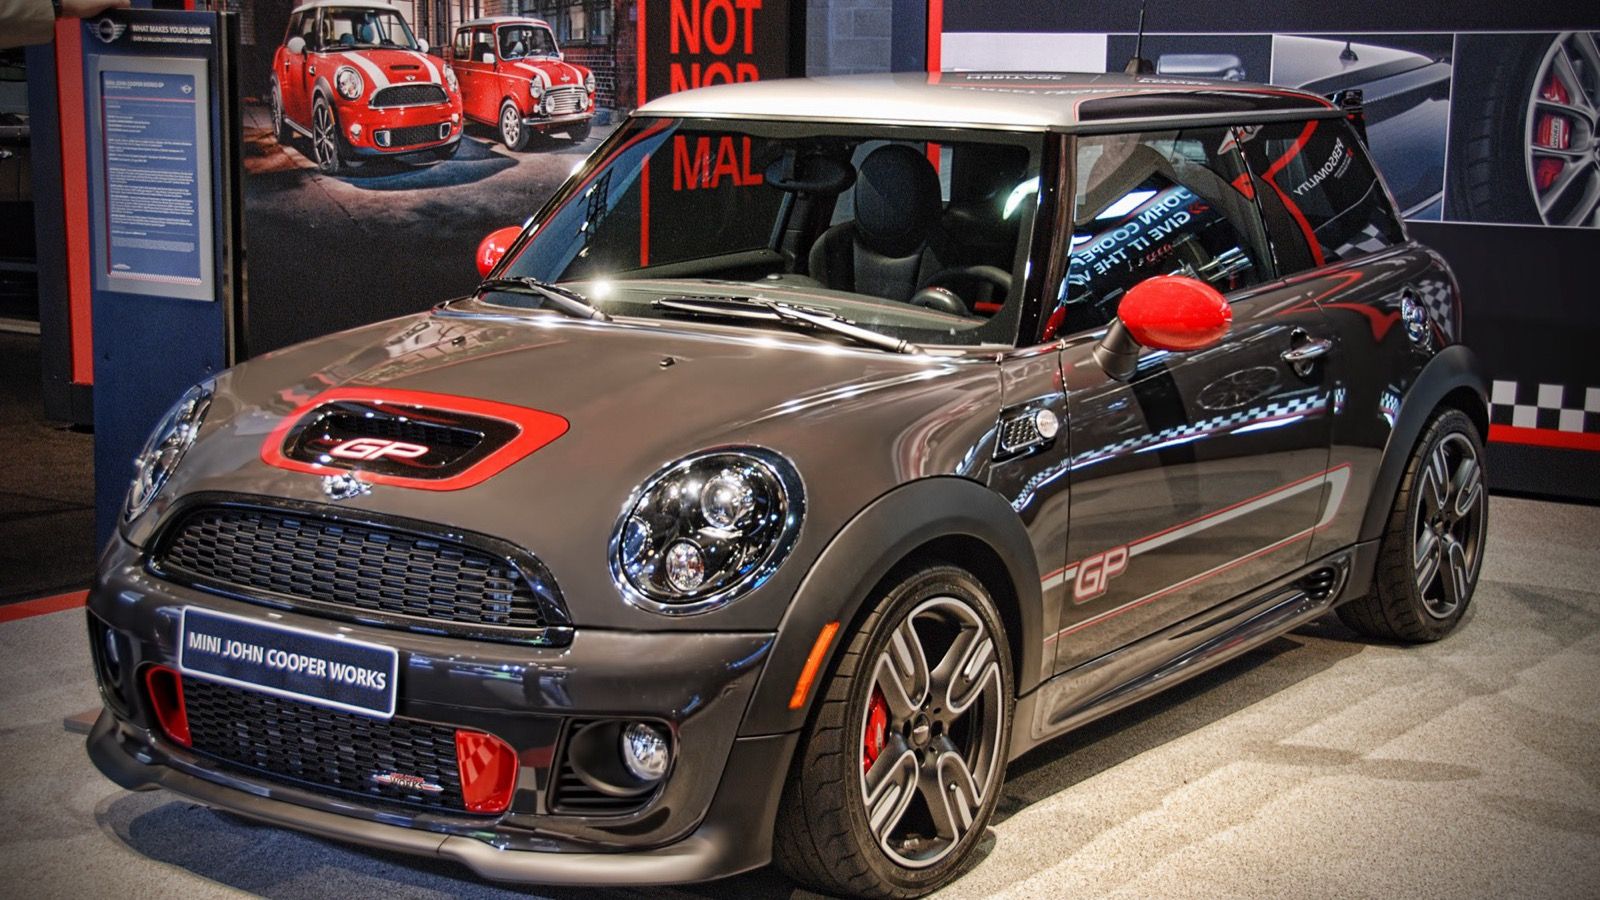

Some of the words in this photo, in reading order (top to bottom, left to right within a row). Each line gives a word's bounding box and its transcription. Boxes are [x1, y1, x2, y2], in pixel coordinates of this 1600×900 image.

[170, 26, 188, 34] YOURS
[189, 27, 211, 35] UNIQUE
[669, 0, 762, 55] NOT
[673, 134, 764, 191] MAL
[330, 437, 429, 460] GP
[1074, 546, 1128, 603] GP
[189, 631, 222, 654] MINI
[223, 639, 264, 664] JOHN
[266, 649, 327, 677] COOPER
[329, 661, 387, 691] WORKS
